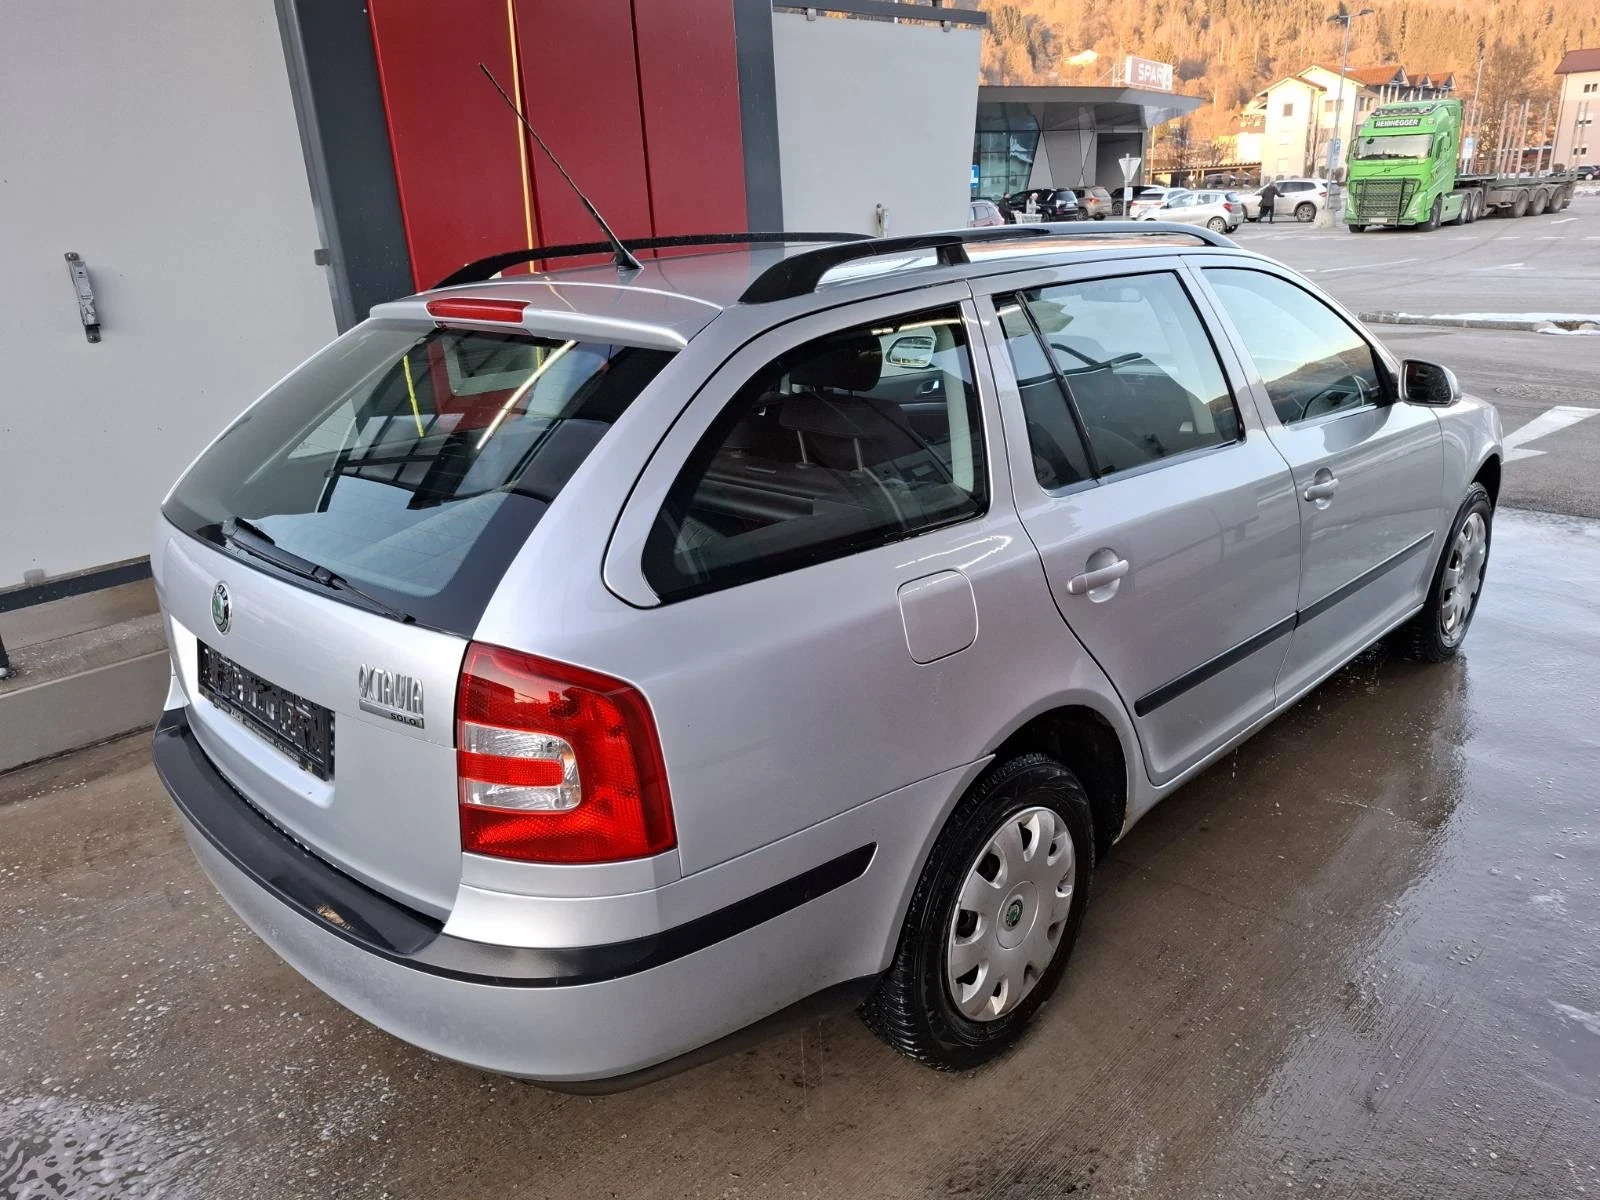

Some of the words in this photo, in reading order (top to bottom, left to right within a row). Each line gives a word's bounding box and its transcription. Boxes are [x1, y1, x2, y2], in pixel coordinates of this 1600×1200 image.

[1138, 62, 1164, 85] SPAR
[358, 663, 424, 715] OCTAVIA
[390, 712, 417, 726] SOLO
